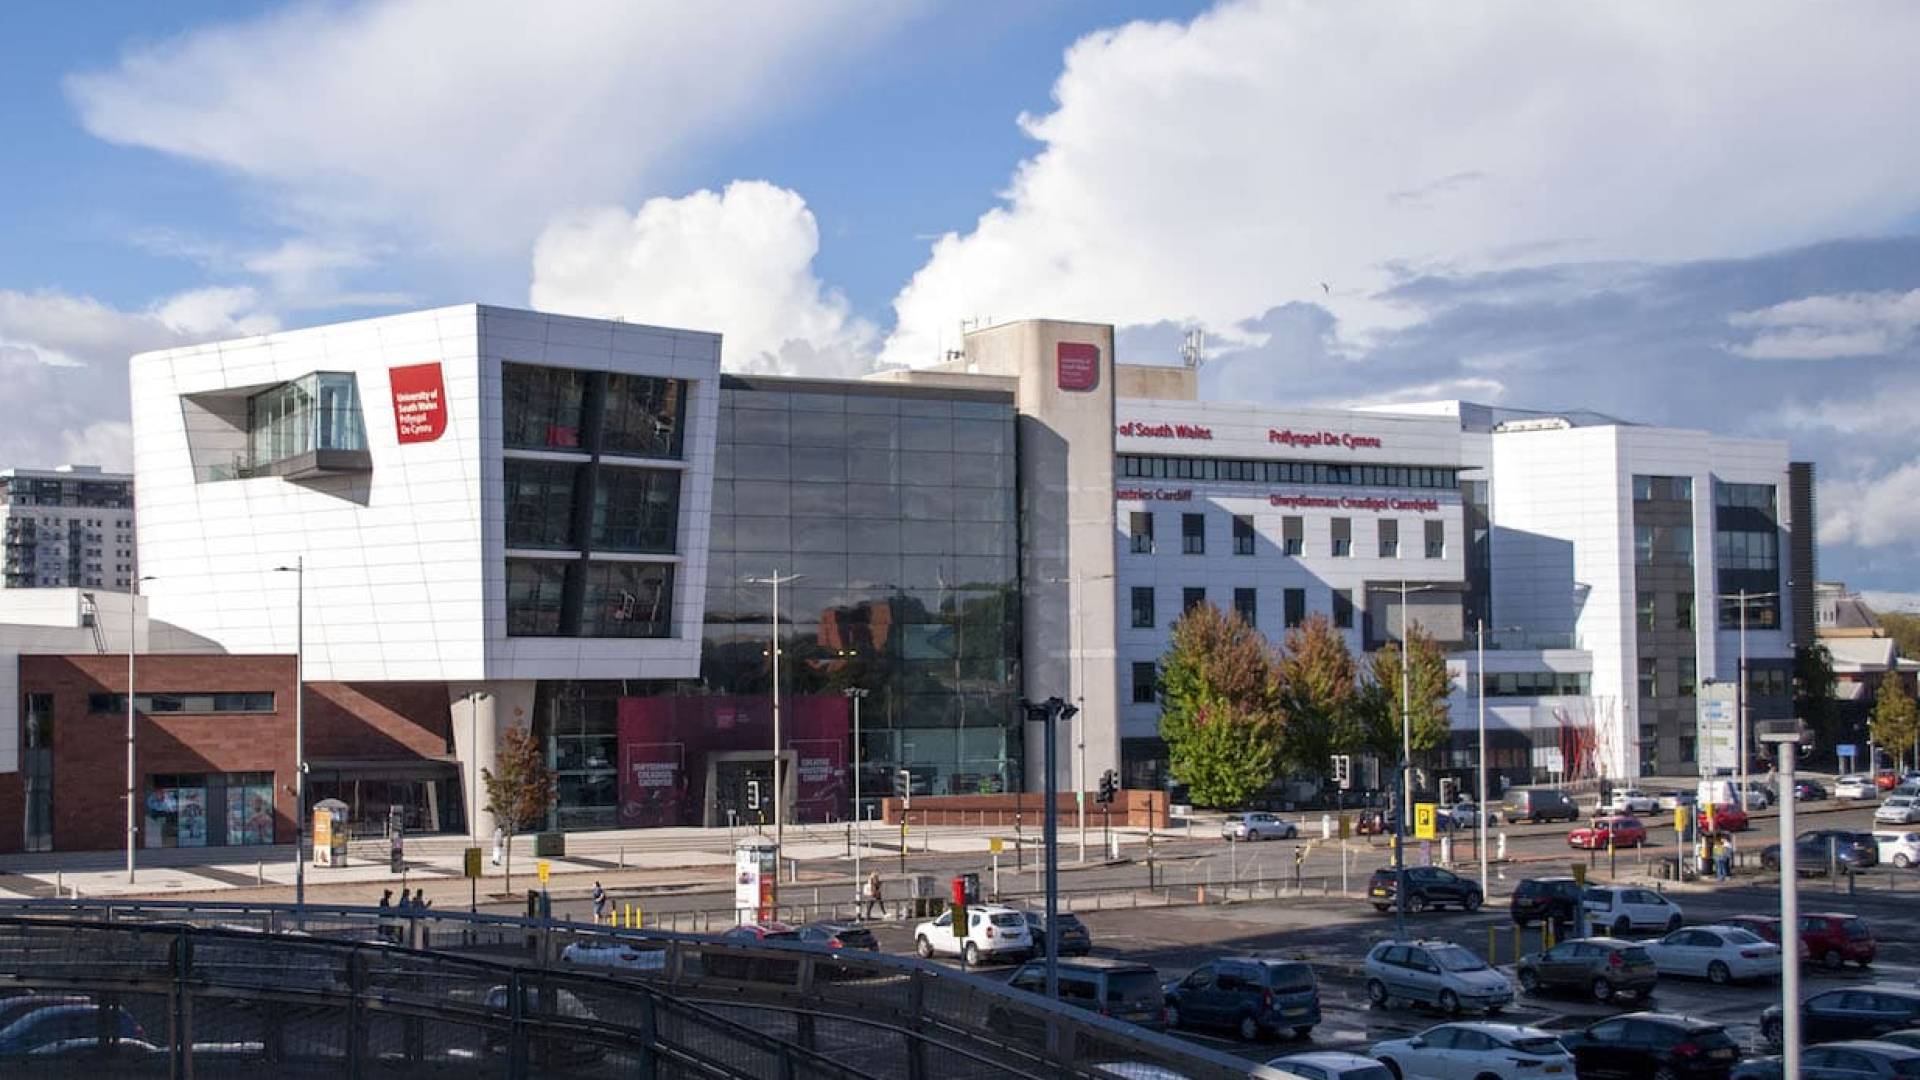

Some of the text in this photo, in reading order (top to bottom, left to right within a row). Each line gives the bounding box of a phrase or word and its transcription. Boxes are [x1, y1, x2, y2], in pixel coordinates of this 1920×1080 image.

[397, 388, 438, 402] University of
[398, 401, 438, 413] South Wales
[399, 412, 427, 425] Prifysgol
[401, 424, 433, 435] De Cymru
[1120, 422, 1213, 440] of South Wales
[1268, 429, 1381, 449] Prifysgol De Cymru
[1116, 488, 1192, 501] ustries Cardiff
[1341, 496, 1388, 512] Creadigol
